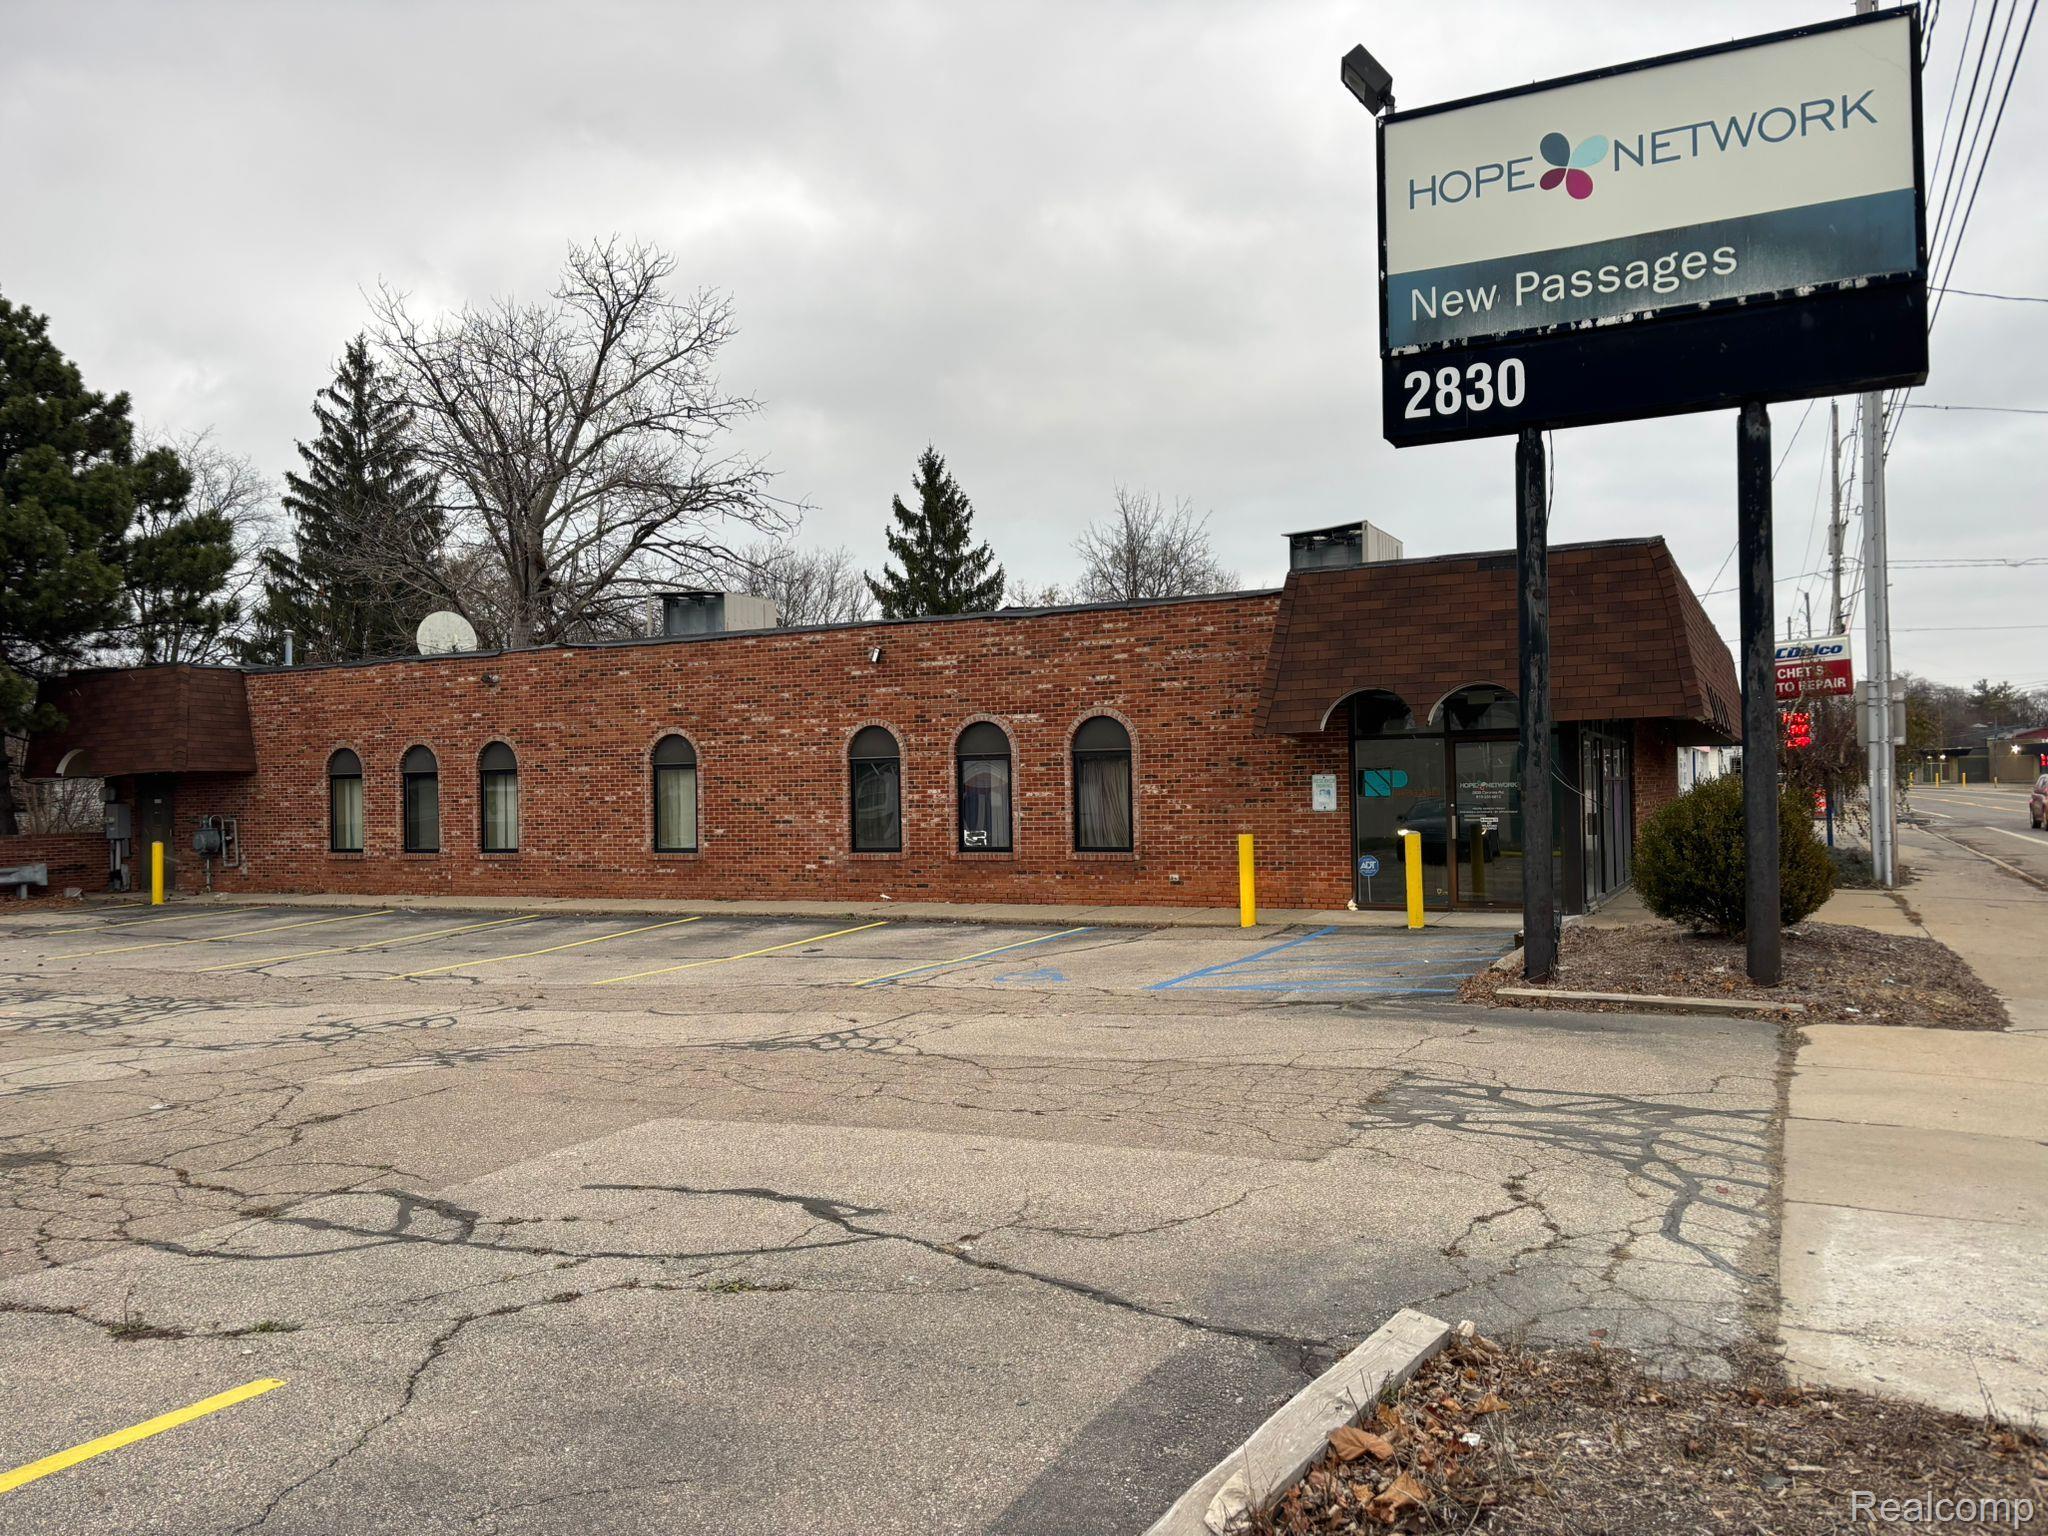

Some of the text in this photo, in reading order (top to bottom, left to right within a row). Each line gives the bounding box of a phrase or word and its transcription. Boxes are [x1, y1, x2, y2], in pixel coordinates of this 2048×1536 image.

[1409, 89, 1879, 210] HOPE NETWORK
[1411, 246, 1737, 321] New Passages
[1404, 357, 1526, 419] 2830
[1775, 677, 1847, 693] TO REPAIR
[1360, 861, 1377, 869] ADT
